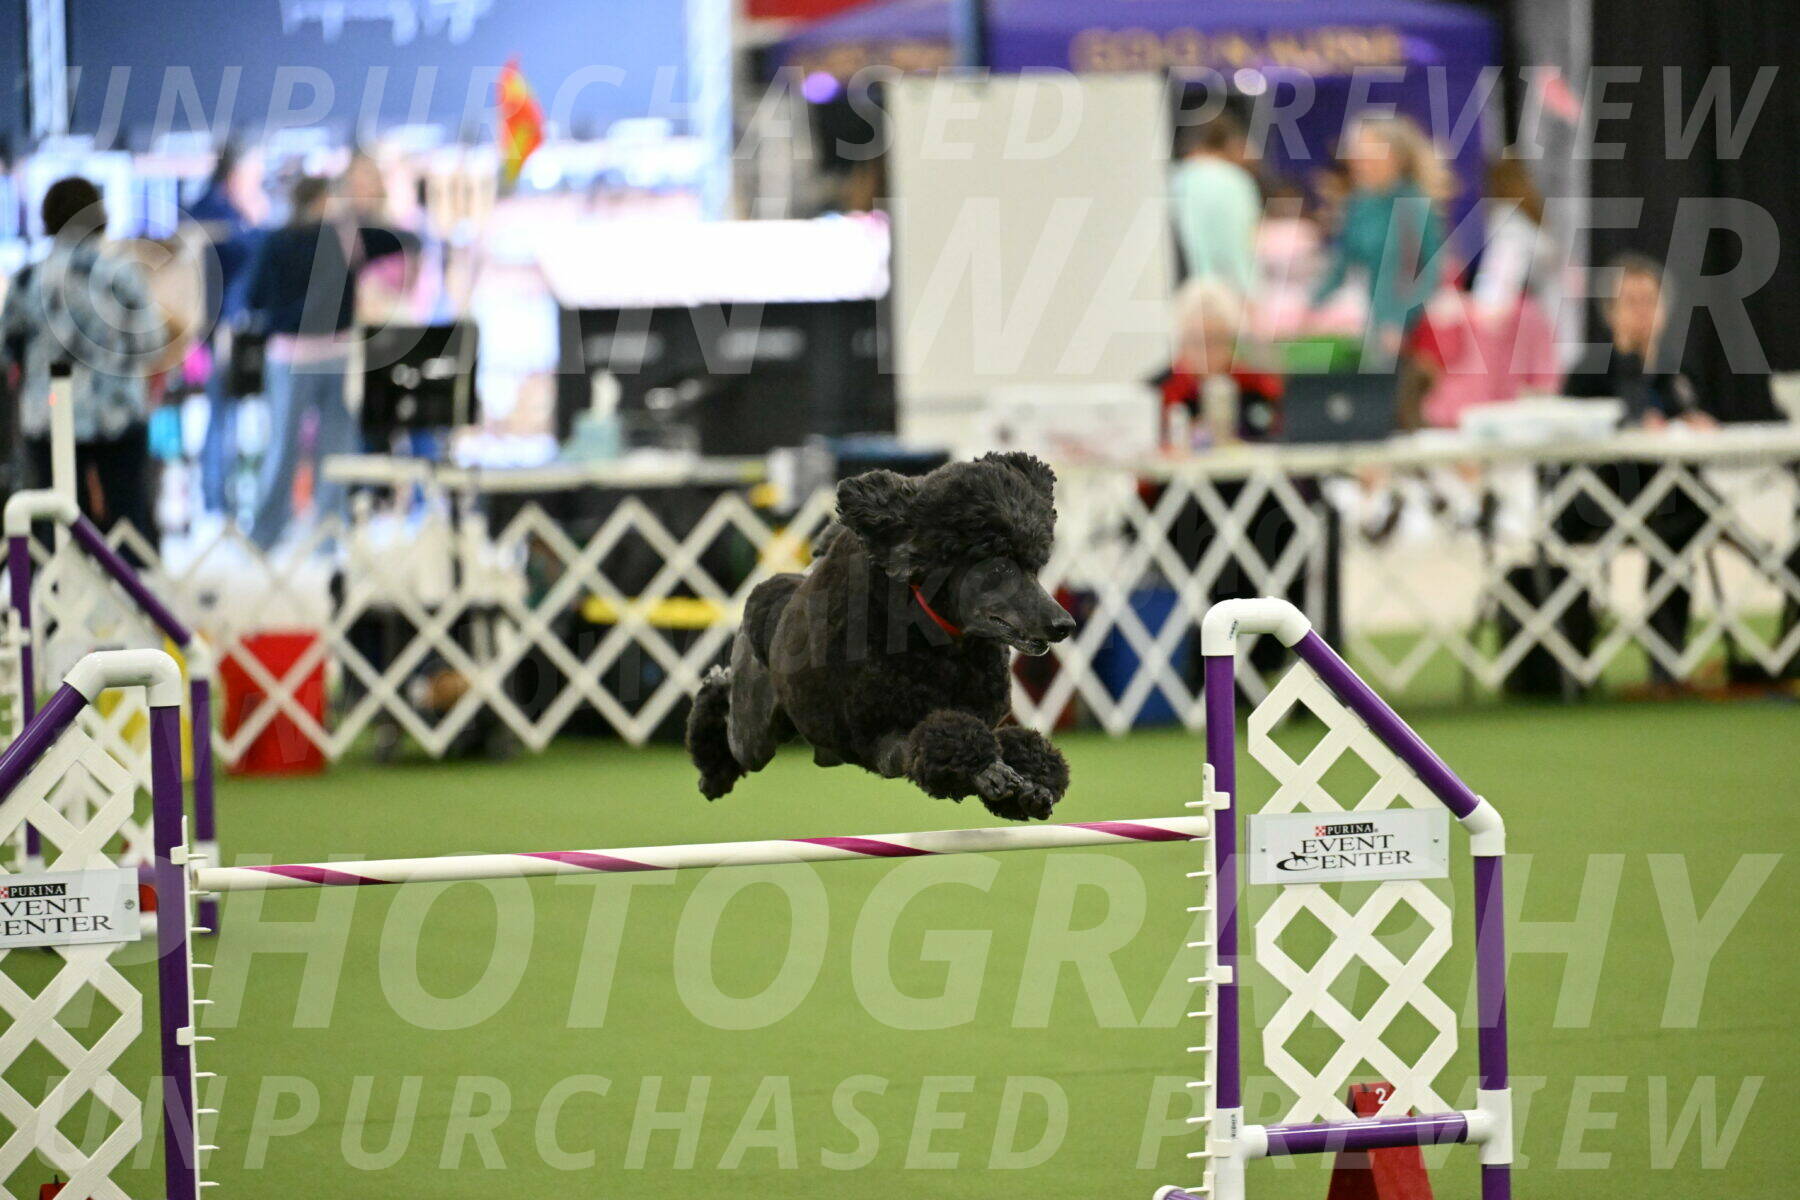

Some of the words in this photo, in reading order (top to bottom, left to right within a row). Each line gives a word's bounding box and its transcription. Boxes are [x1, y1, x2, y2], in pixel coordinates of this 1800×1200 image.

[1301, 834, 1394, 854] EVENT
[1276, 850, 1413, 871] CENTER
[10, 885, 65, 897] PURINA
[0, 897, 90, 917] VENT
[0, 915, 113, 937] ENTER
[1375, 1087, 1388, 1105] 2
